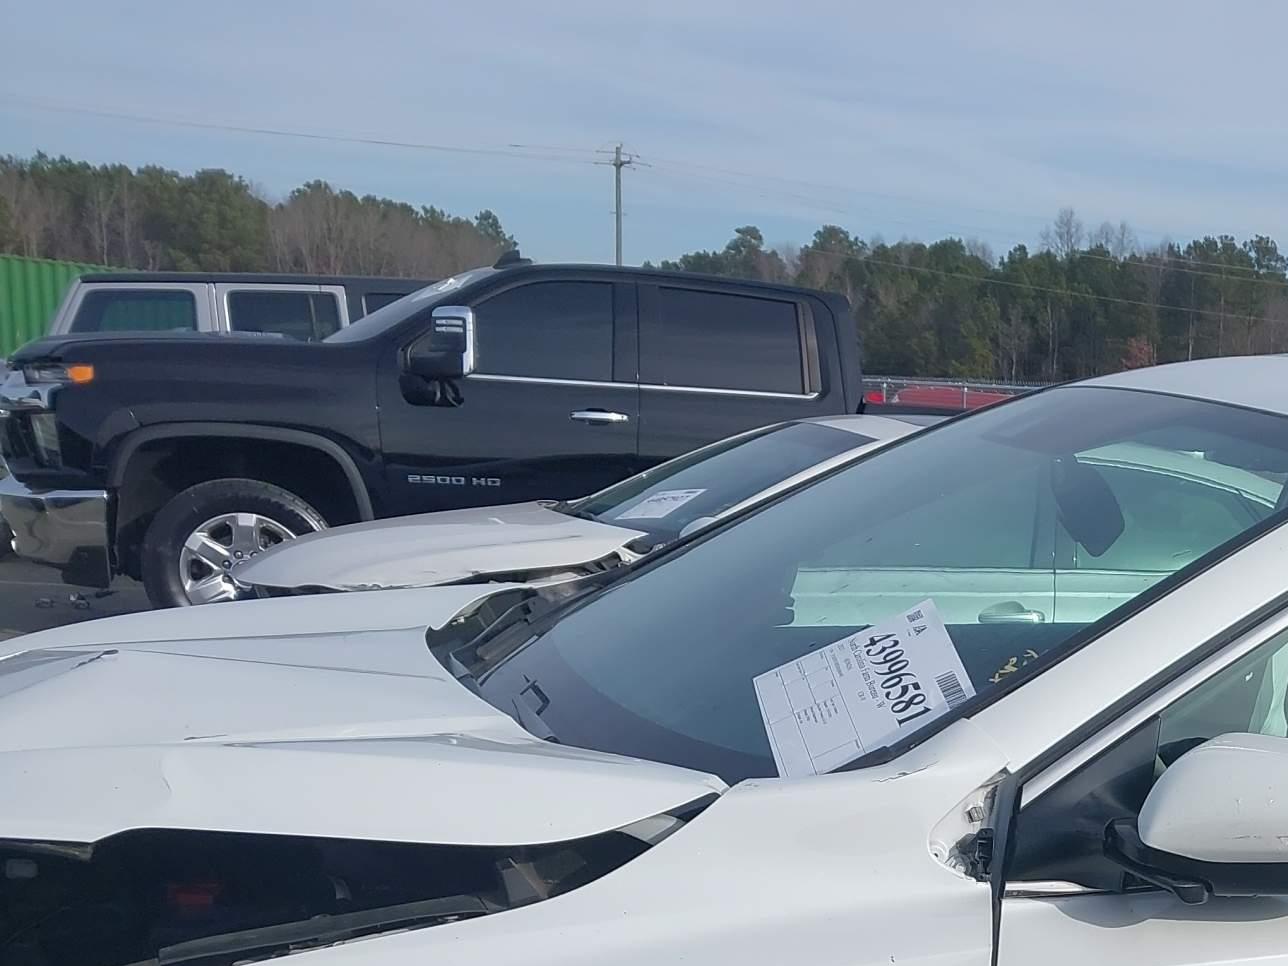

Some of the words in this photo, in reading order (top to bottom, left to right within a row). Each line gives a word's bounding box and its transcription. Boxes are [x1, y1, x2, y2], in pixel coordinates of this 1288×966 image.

[407, 474, 465, 485] 2500
[471, 477, 501, 487] HD
[863, 633, 932, 728] 43996581
